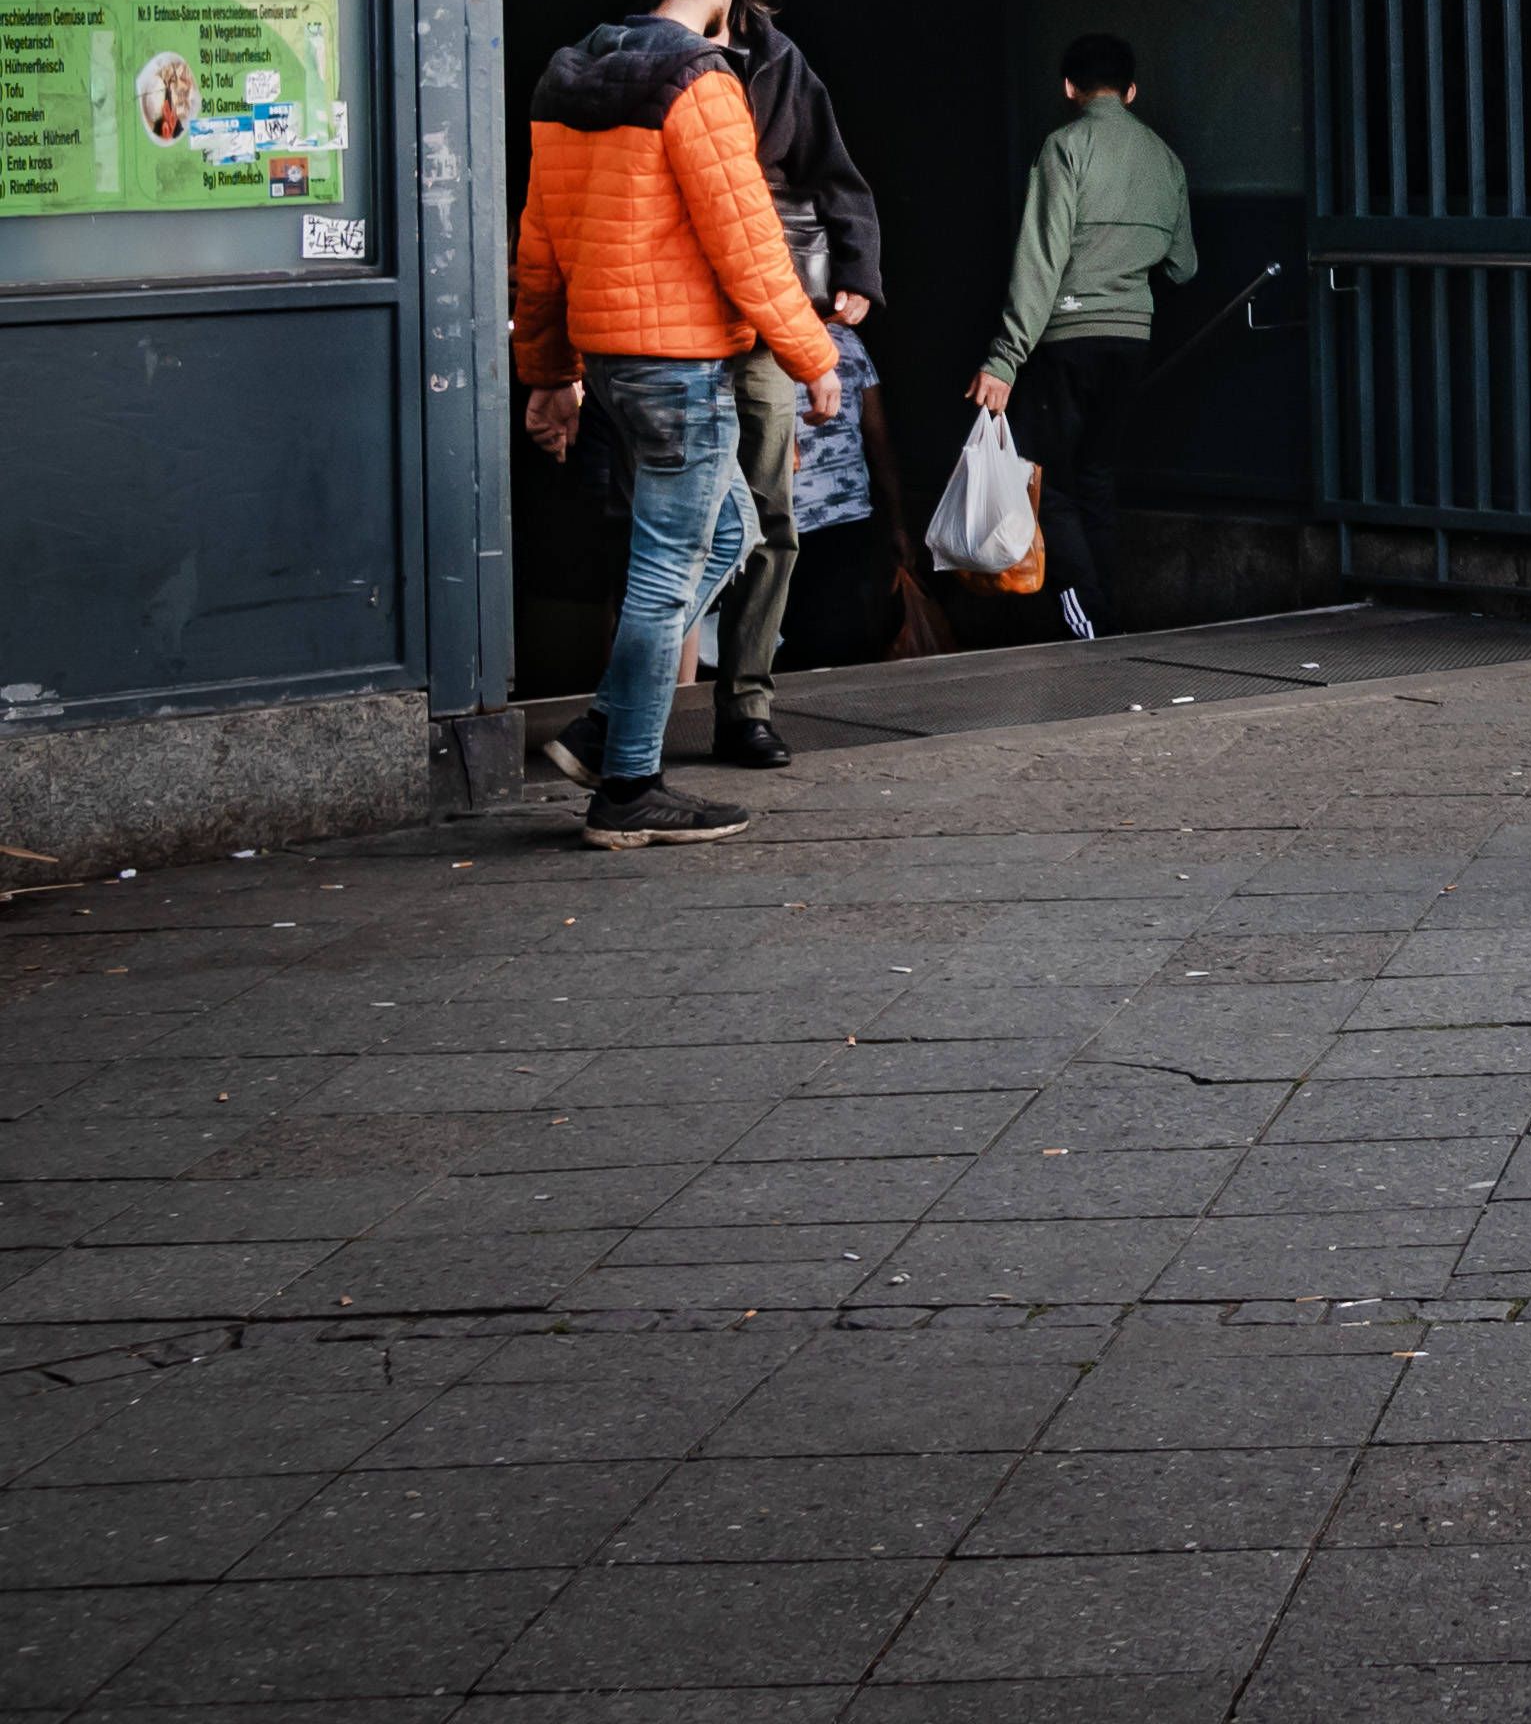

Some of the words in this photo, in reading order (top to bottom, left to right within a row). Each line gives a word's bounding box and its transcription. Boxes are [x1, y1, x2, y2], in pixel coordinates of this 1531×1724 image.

[53, 6, 86, 26] Gemüse
[259, 4, 283, 19] Gemüse
[214, 24, 262, 42] Vegetarisch
[4, 34, 54, 54] Vegetarisch
[215, 48, 271, 64] Hühnerfleisch
[4, 58, 65, 74] Hühnerfleisch
[216, 73, 234, 89] Tofu
[5, 82, 25, 99] Tofu
[6, 107, 45, 123] Garnelen
[7, 155, 27, 171] Ente
[29, 155, 53, 171] kross
[218, 170, 264, 186] Rindfleisch
[10, 178, 58, 195] Rindfleisch
